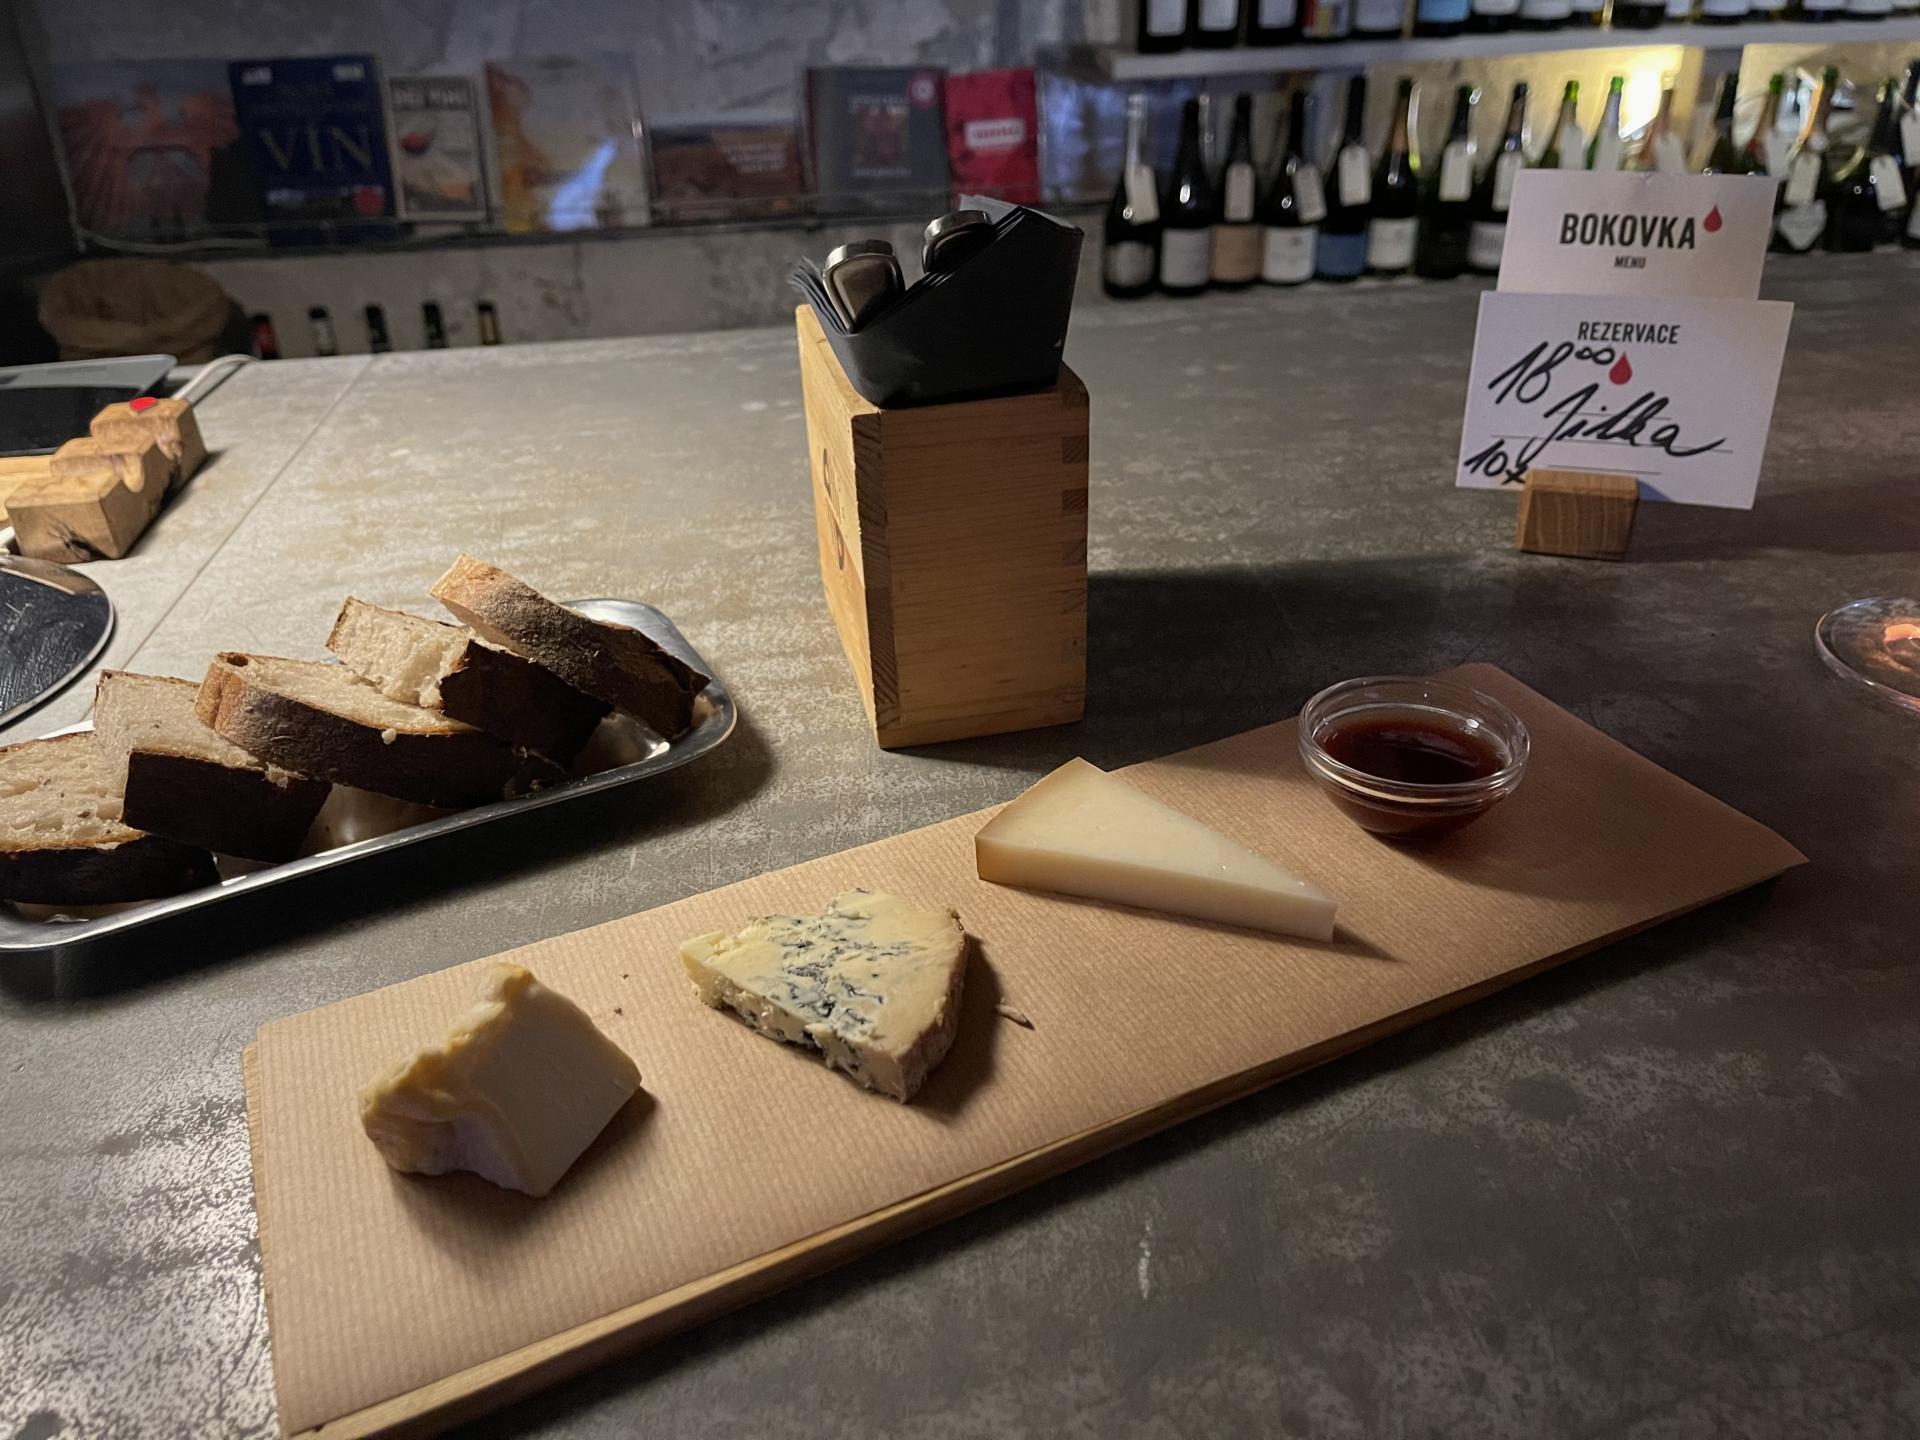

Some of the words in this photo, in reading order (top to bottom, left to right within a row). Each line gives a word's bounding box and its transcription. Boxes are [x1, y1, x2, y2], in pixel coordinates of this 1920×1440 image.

[1560, 213, 1696, 249] BOKOVKA
[1614, 256, 1646, 269] MENU
[1577, 321, 1681, 345] REZERVACE
